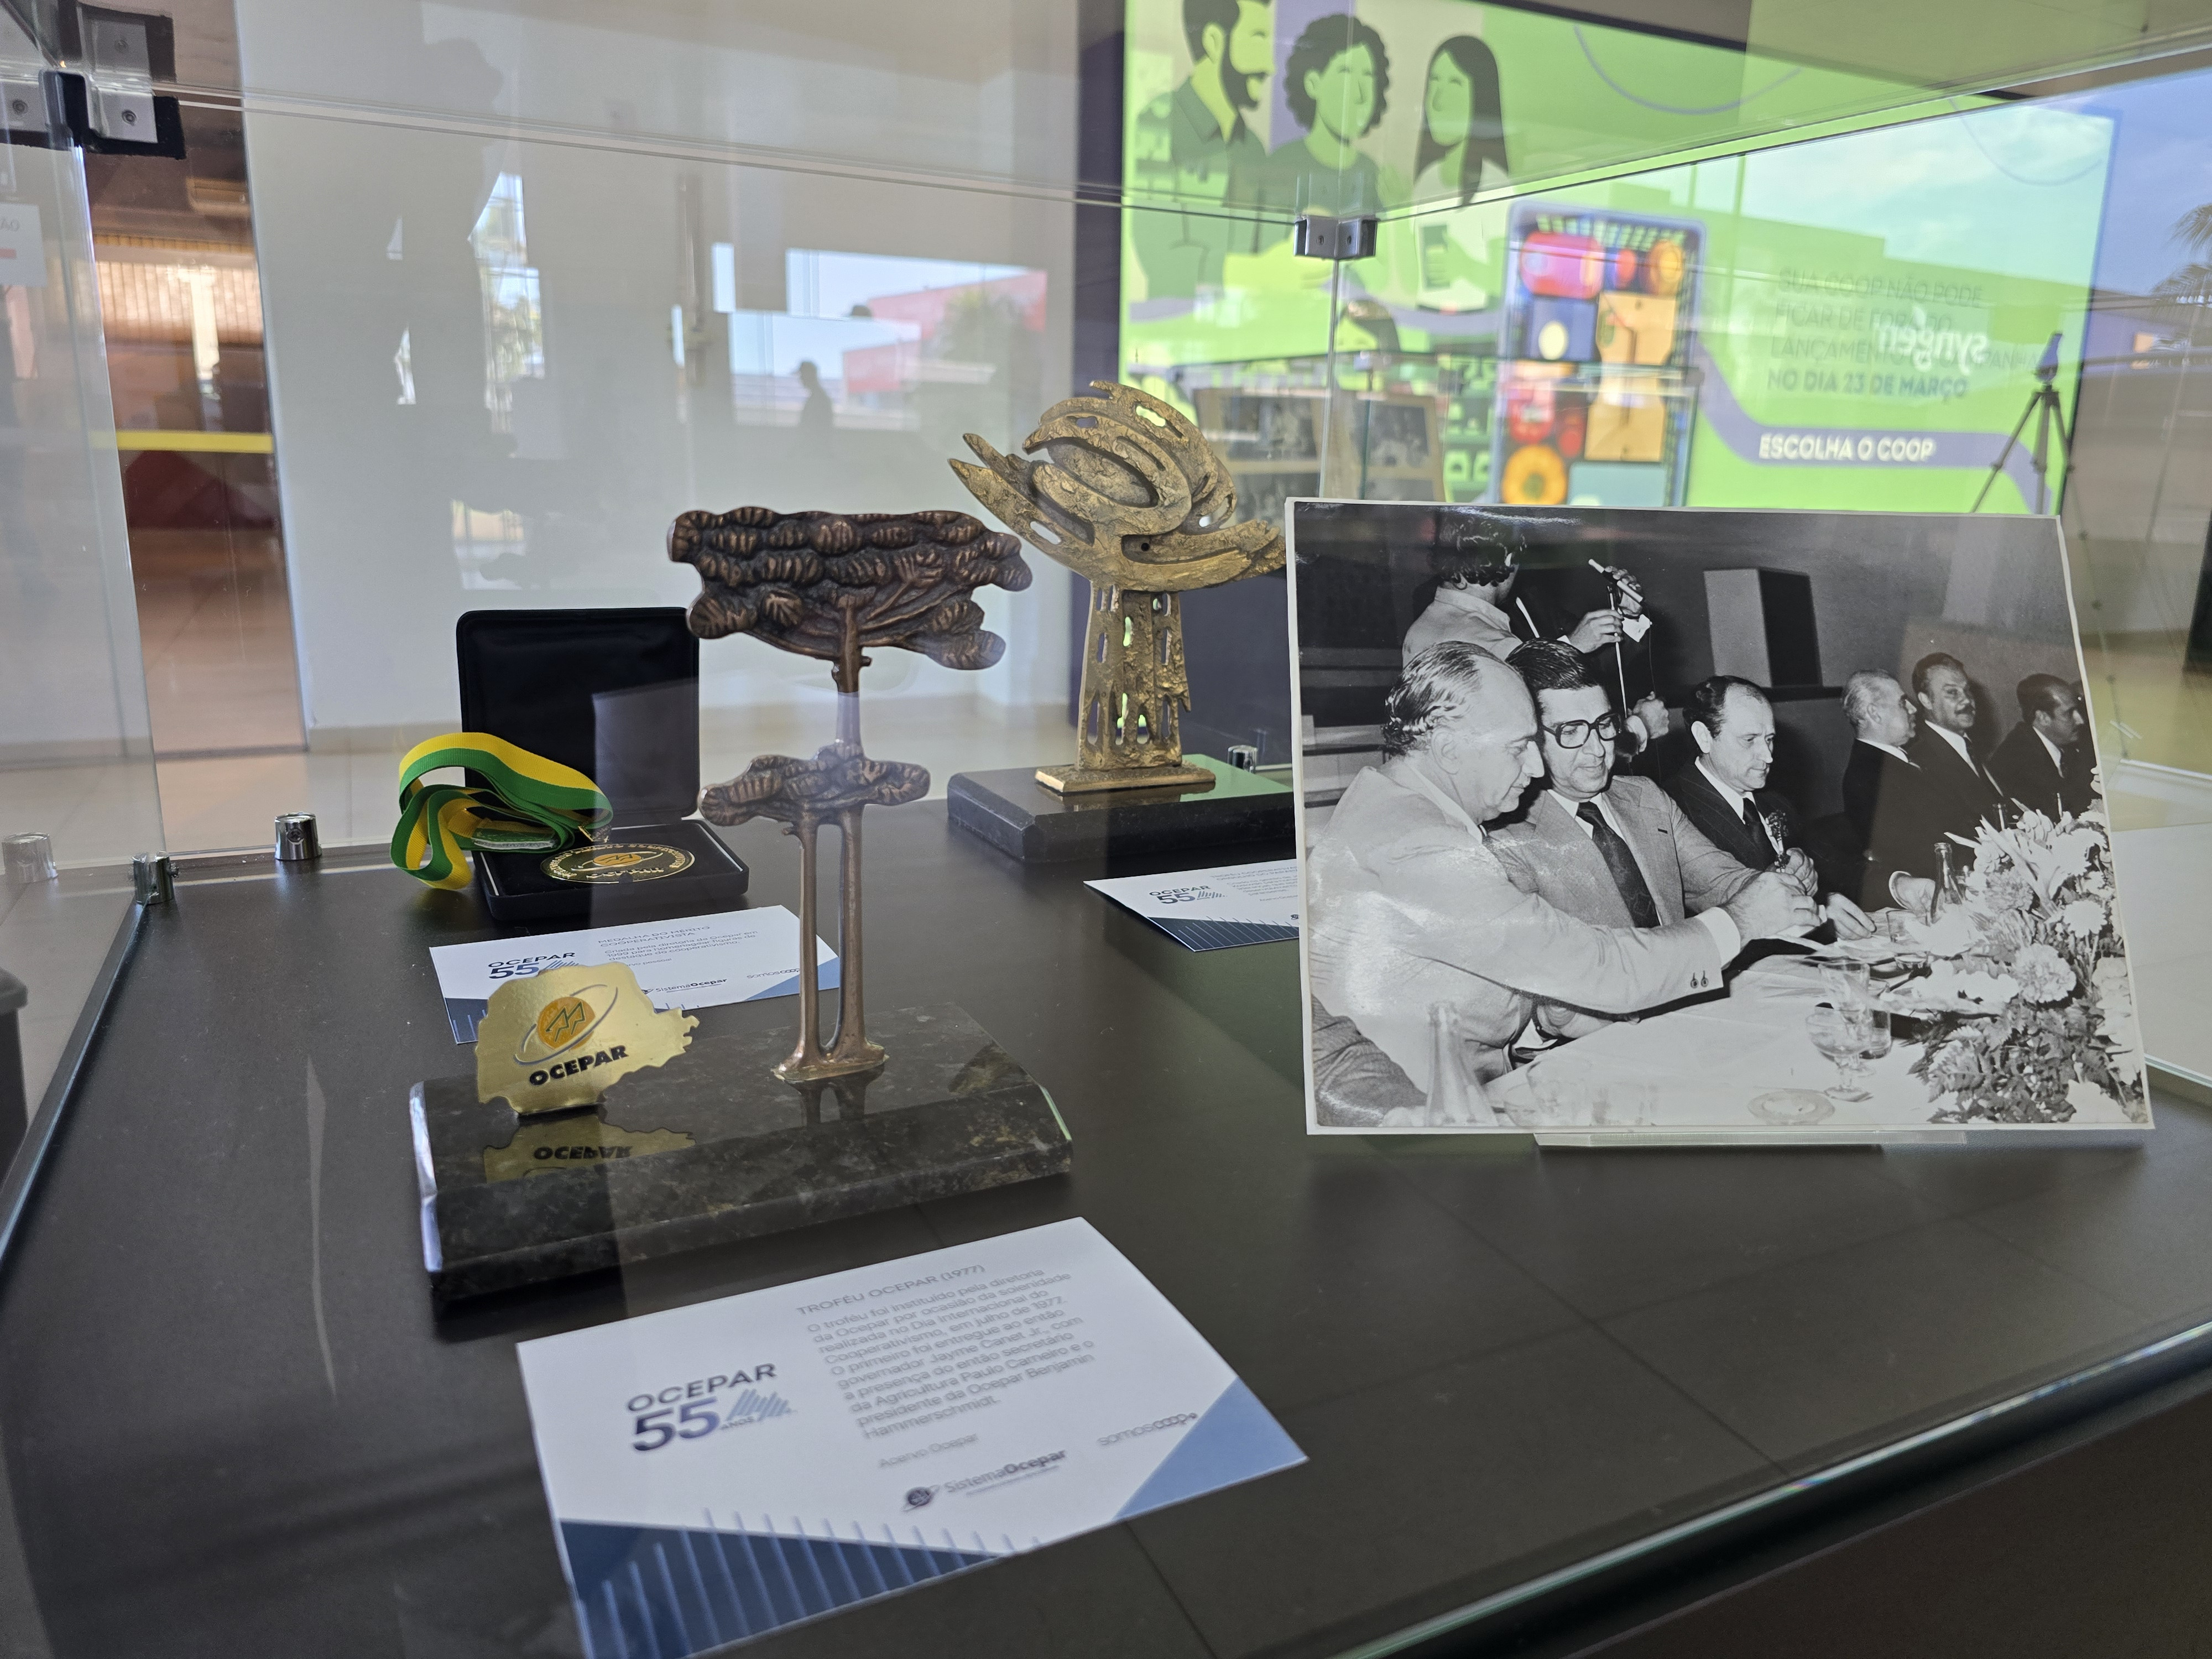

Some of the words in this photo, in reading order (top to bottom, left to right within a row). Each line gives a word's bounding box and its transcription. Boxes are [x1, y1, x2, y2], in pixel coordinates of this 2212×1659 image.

[1778, 267, 1819, 294] SUA
[1886, 274, 1928, 303] NÃO
[1932, 283, 1984, 307] PODE
[1775, 302, 1833, 327] FICAR
[1838, 305, 1868, 331] DE
[1767, 368, 1798, 392] NO
[1803, 370, 1838, 393] DIA
[1843, 371, 1865, 395] 23
[1869, 371, 1894, 395] DE
[1898, 373, 1968, 405] MARÇO
[1759, 433, 1854, 461] ESCOLHA
[1857, 435, 1874, 462] O
[1876, 436, 1936, 462] COOP
[1149, 885, 1211, 896] OCEPAR
[1156, 892, 1196, 904] 55
[598, 934, 650, 943] MEDALHA
[670, 926, 710, 934] MÉRITO
[600, 932, 696, 947] COOPERATIVISTA
[654, 941, 710, 951] homenagear
[658, 938, 695, 947] diretoria
[488, 952, 576, 968] OCEPAR
[488, 962, 540, 979] 55
[609, 952, 653, 961] destaque
[643, 957, 672, 966] pessoal
[656, 978, 728, 992] SistemaOcepar
[529, 1045, 629, 1086] OCEPAR
[796, 1292, 865, 1315] TROFÉU
[868, 1275, 938, 1297] OCEPAR
[940, 1264, 986, 1281] (1977)
[807, 1323, 821, 1333] O
[823, 1312, 868, 1328] troféu
[869, 1306, 890, 1317] foi
[890, 1290, 956, 1312] instituído
[958, 1283, 988, 1296] pela
[989, 1269, 1045, 1287] diretoria
[813, 1333, 833, 1343] da
[835, 1318, 890, 1336] Ocepar
[893, 1311, 918, 1324] por
[920, 1297, 977, 1315] ocasião
[977, 1291, 997, 1301] da
[998, 1273, 1072, 1296] solenidade
[818, 1331, 886, 1354] realizada
[889, 1326, 909, 1335] no
[910, 1318, 936, 1330] Dia
[937, 1293, 1027, 1323] Internacional
[1029, 1290, 1048, 1299] do
[948, 1320, 974, 1332] em
[974, 1311, 1010, 1328] julho
[1010, 1306, 1031, 1316] de
[831, 1365, 846, 1375] O
[848, 1349, 911, 1374] primeiro
[912, 1343, 933, 1354] foi
[933, 1326, 1001, 1348] entregue
[1001, 1321, 1022, 1331] ao
[1023, 1309, 1065, 1325] então
[836, 1358, 925, 1390] governador
[929, 1344, 979, 1363] Jayme
[979, 1332, 1027, 1348] Canet
[1051, 1317, 1084, 1329] com
[843, 1391, 855, 1400] a
[857, 1371, 931, 1399] presença
[931, 1364, 954, 1376] do
[956, 1352, 1001, 1369] então
[1001, 1332, 1074, 1357] secretário
[849, 1400, 873, 1412] da
[875, 1376, 959, 1406] Agricultura
[959, 1364, 1005, 1381] Paulo
[1005, 1347, 1069, 1369] Carneiro
[1070, 1343, 1081, 1352] e
[1082, 1340, 1095, 1348] o
[626, 1363, 778, 1412] OCEPAR
[857, 1396, 942, 1428] presidente
[945, 1389, 967, 1401] da
[966, 1372, 1024, 1394] Ocepar
[1024, 1353, 1096, 1379] Benjamin
[633, 1395, 721, 1452] 55
[943, 1449, 1066, 1493] SistemaOcepar
